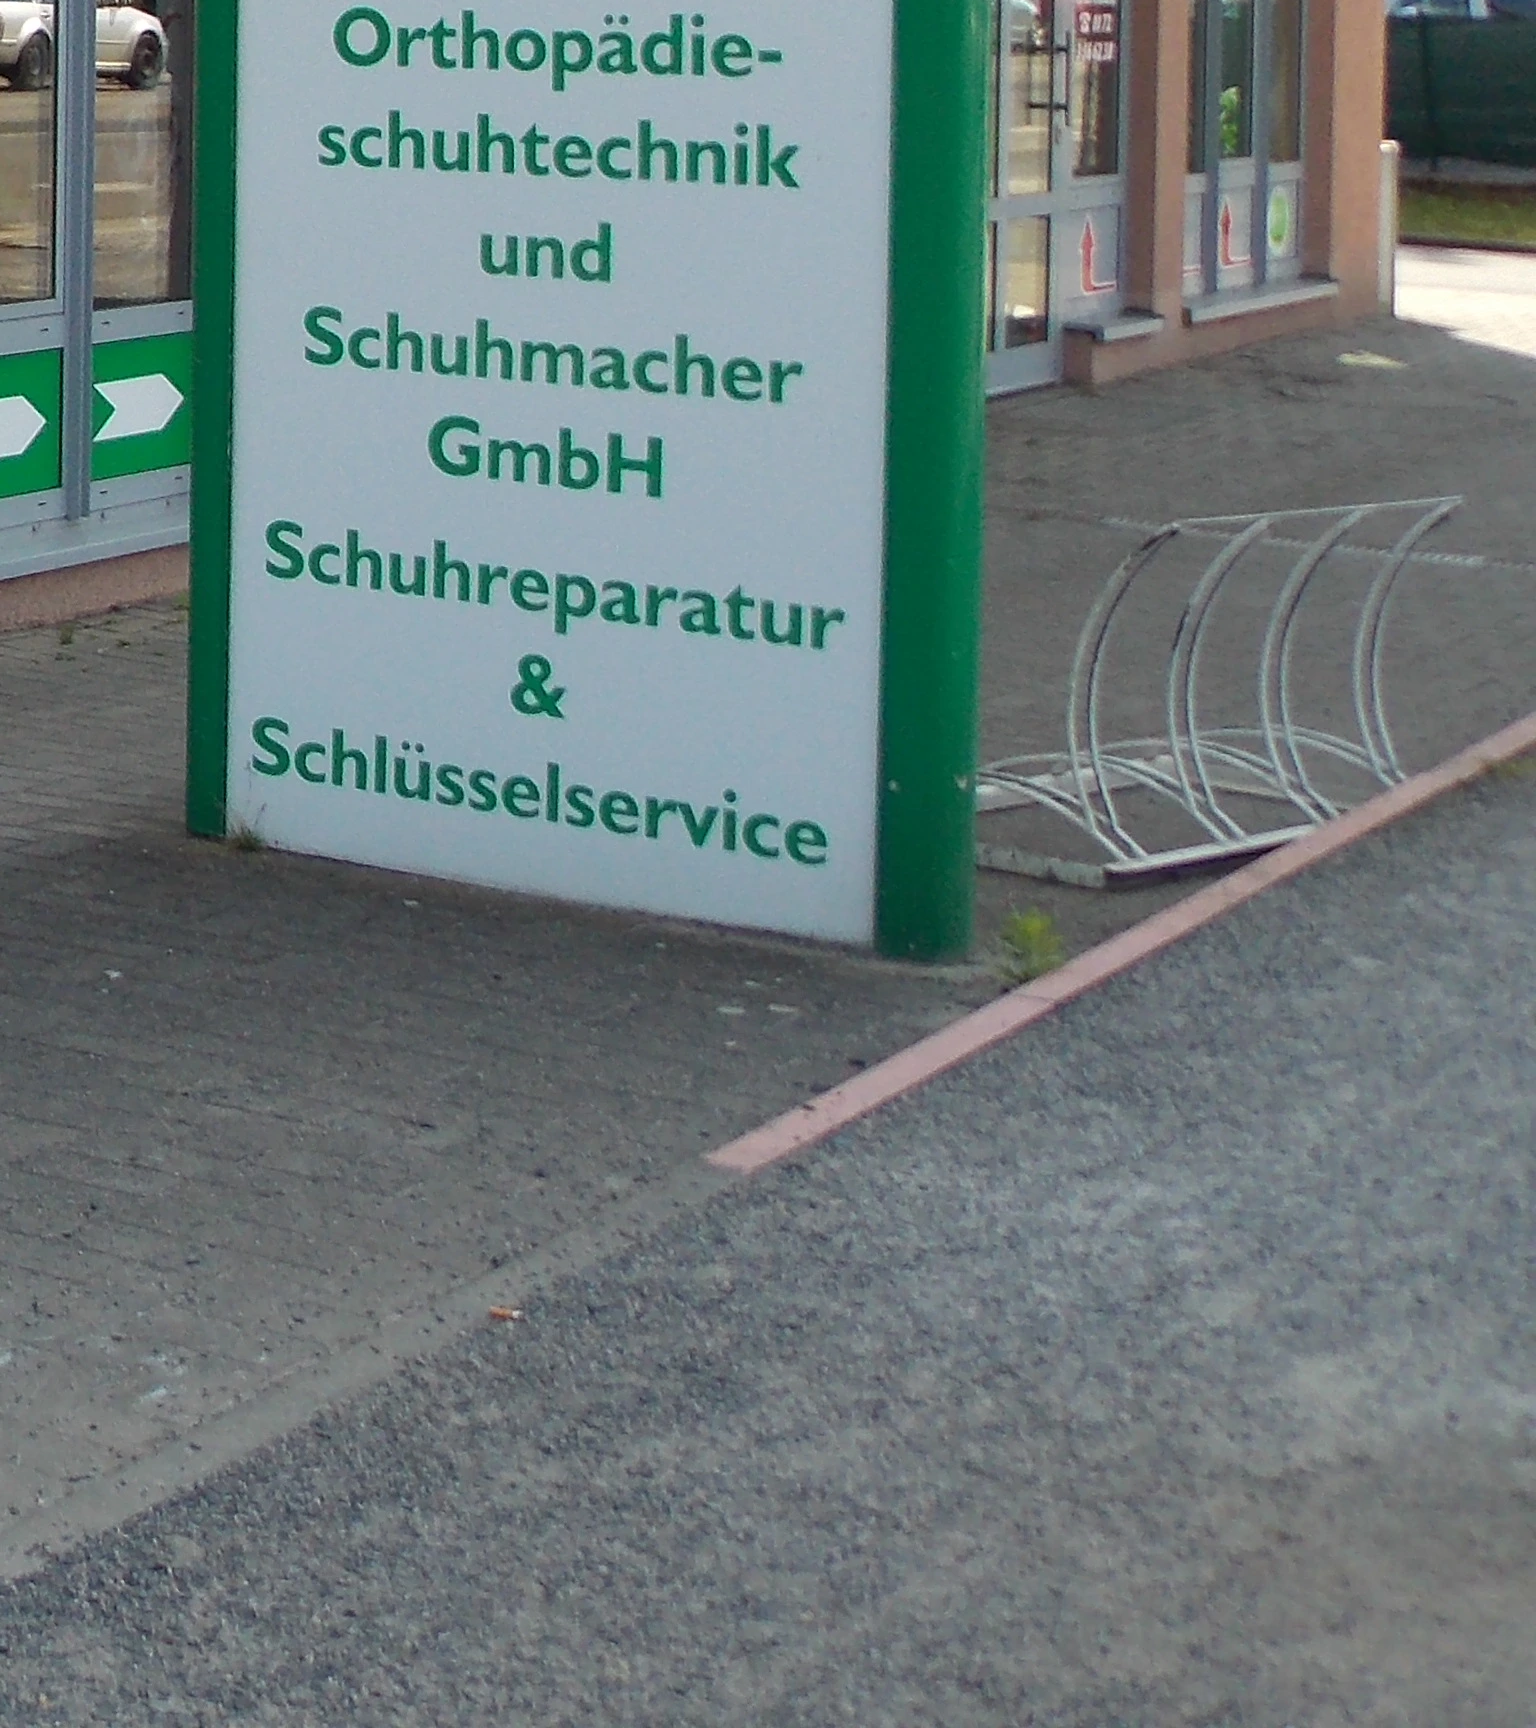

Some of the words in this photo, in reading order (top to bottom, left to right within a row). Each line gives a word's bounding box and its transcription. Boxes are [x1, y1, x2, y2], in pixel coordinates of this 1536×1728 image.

[332, 3, 788, 95] Orthopädie-
[318, 108, 804, 192] schuhtechnik
[480, 220, 618, 286] und
[302, 305, 809, 408] Schuhmacher
[427, 414, 670, 504] GmbH
[264, 518, 850, 654] Schuhreparatur
[509, 653, 569, 722] &
[251, 714, 833, 872] Schlüsselservice
